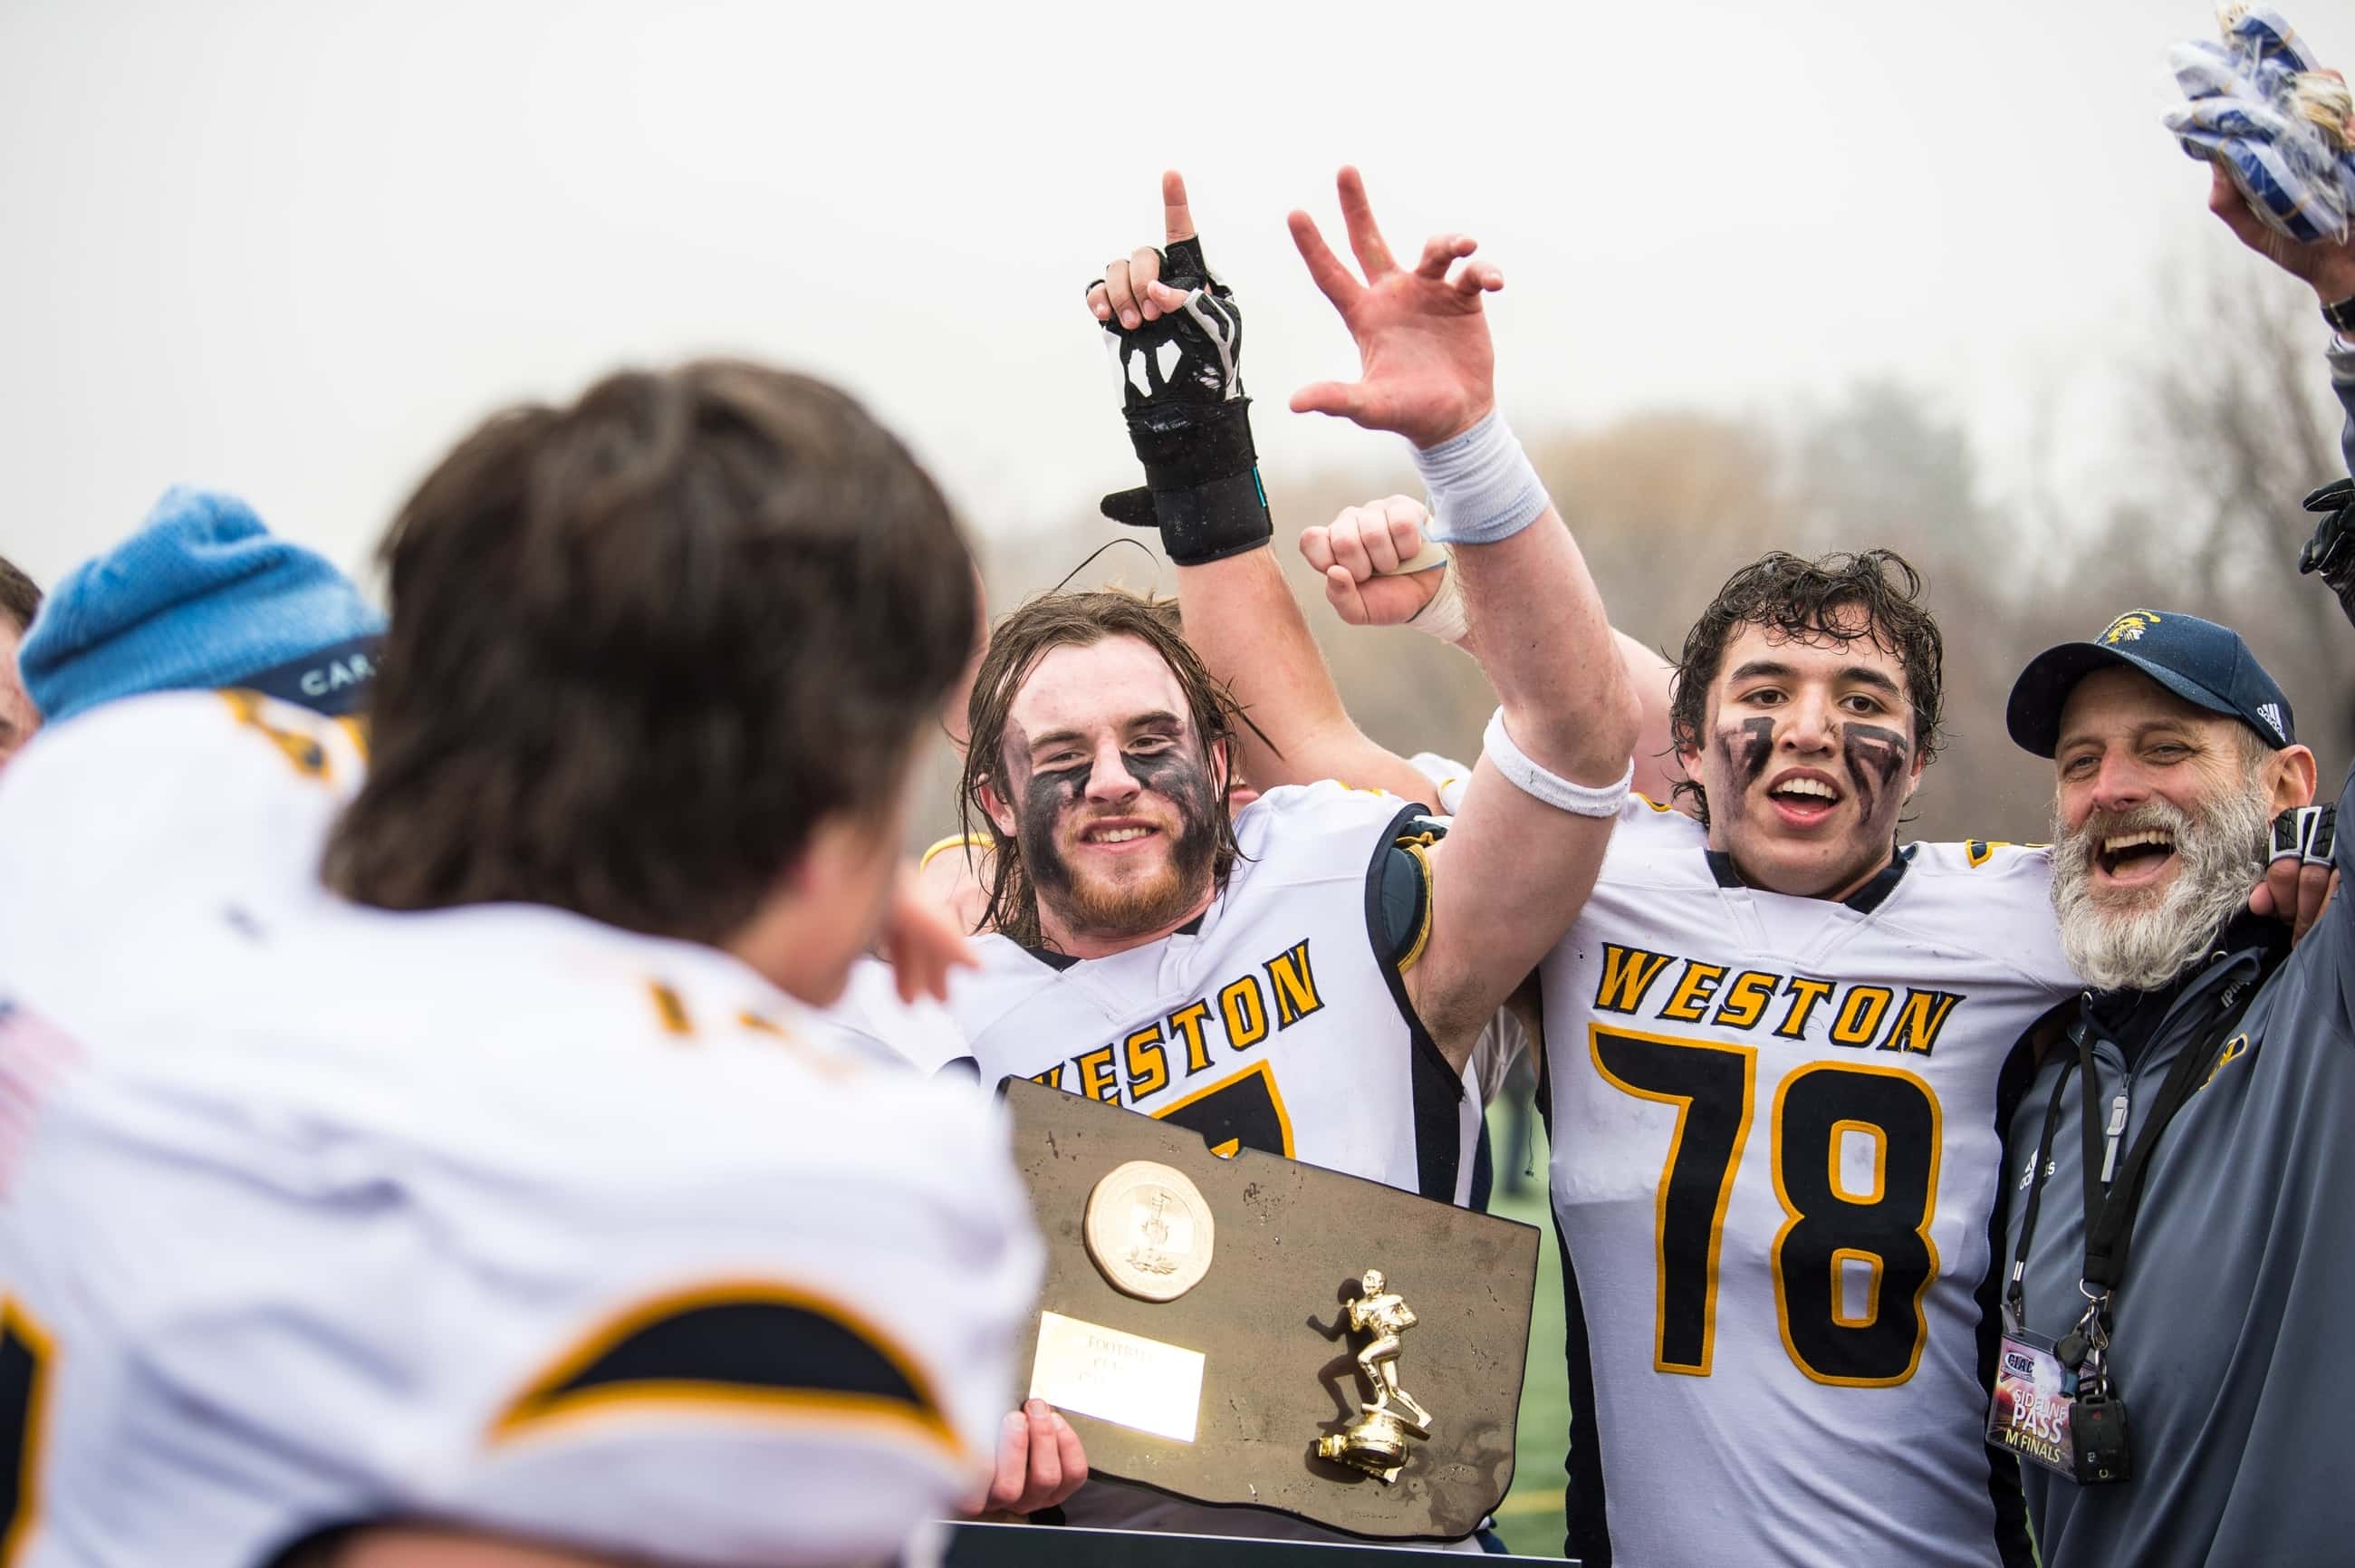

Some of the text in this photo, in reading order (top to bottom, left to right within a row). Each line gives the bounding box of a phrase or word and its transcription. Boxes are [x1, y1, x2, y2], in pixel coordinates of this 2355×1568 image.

[301, 654, 378, 696] CAR
[1592, 942, 1967, 1057] WESTON
[1033, 938, 1325, 1108] ESTON
[1588, 1022, 1943, 1388] 78
[2007, 1353, 2035, 1374] CIAC
[2012, 1404, 2062, 1444] PASS
[2005, 1428, 2061, 1463] M FINALS
